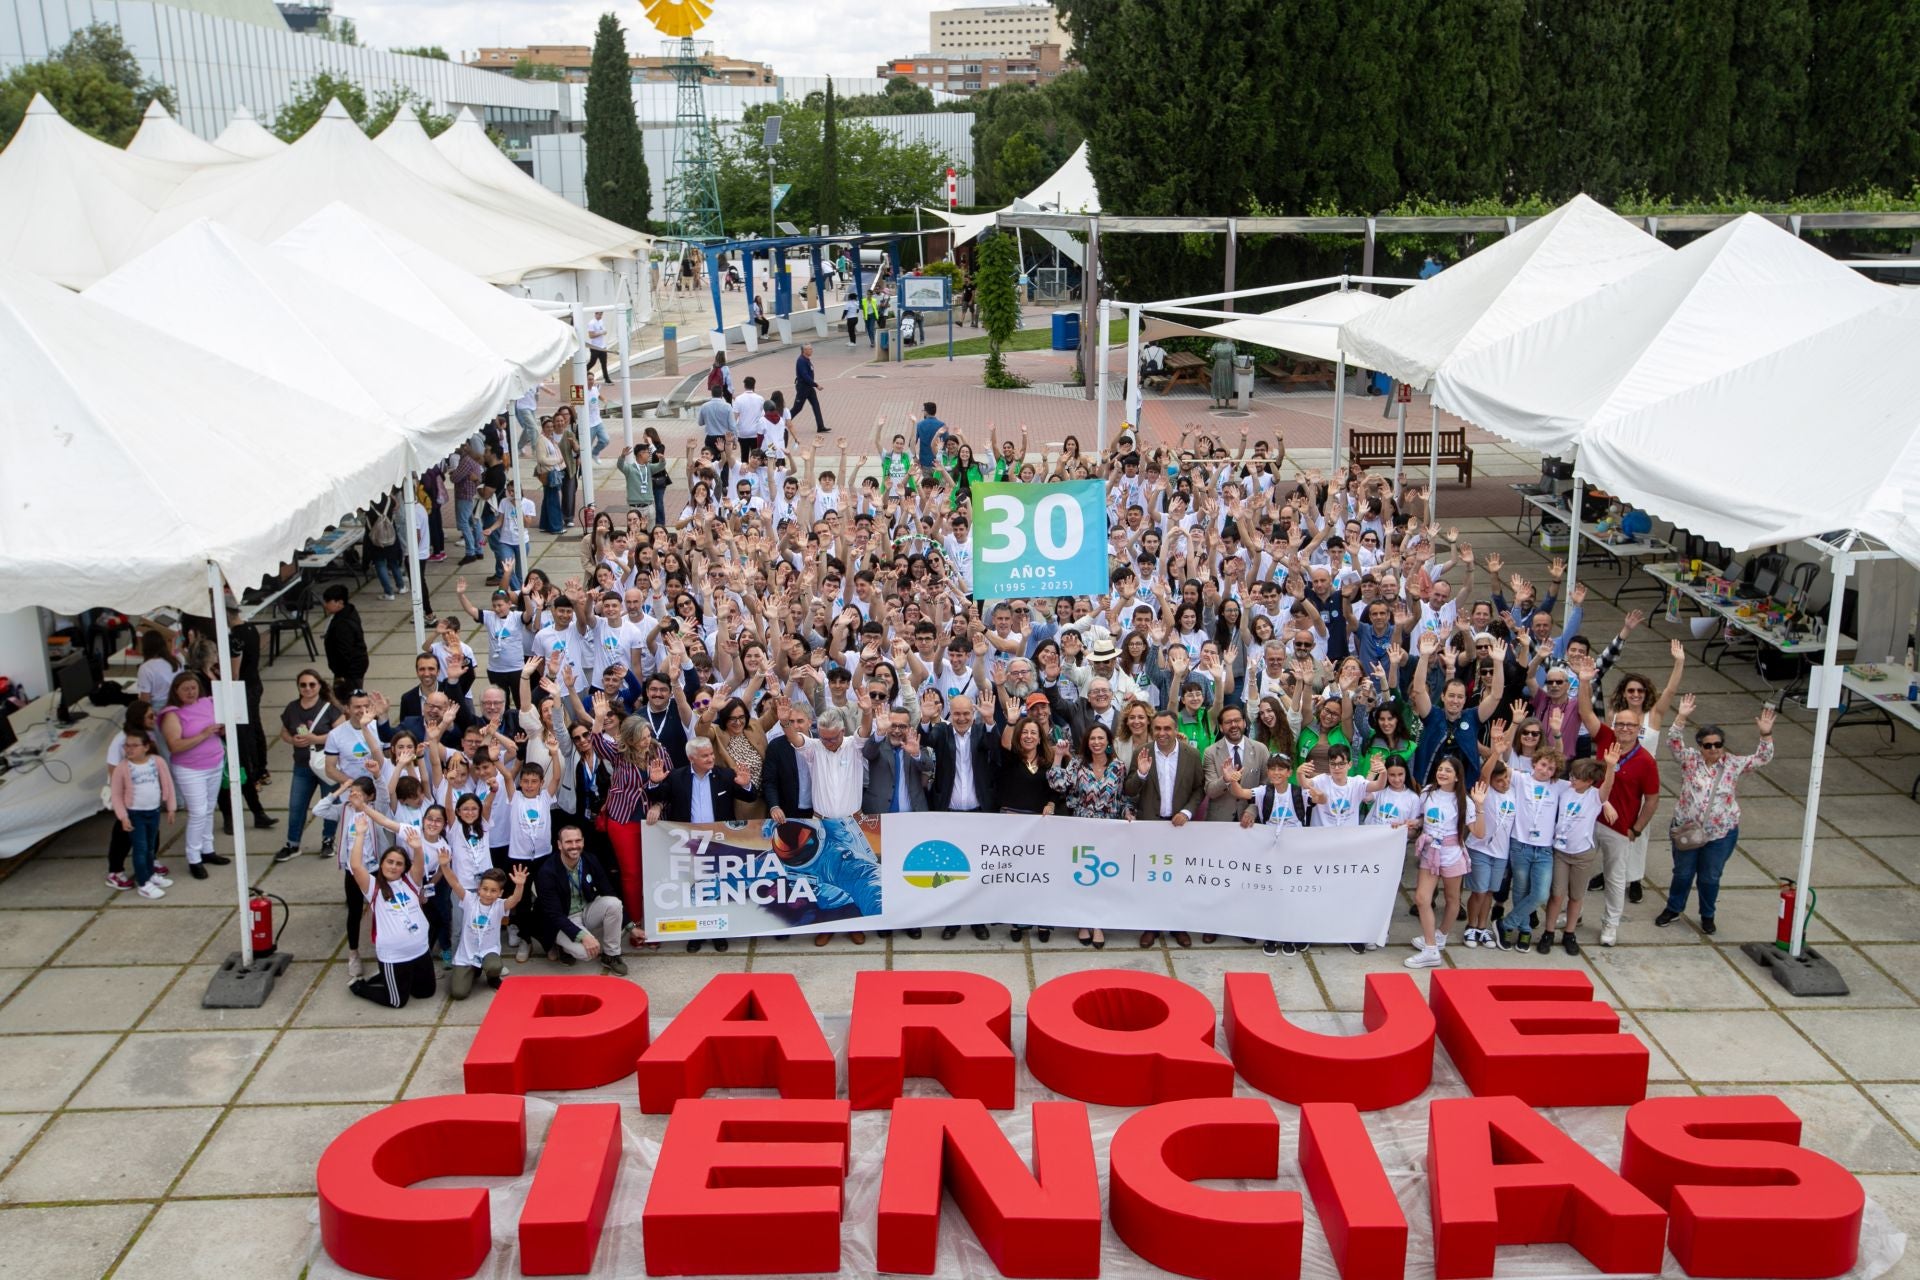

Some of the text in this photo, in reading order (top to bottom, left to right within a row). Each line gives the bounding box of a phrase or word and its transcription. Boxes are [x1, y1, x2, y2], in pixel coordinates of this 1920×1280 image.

[982, 493, 1084, 563] 30
[1010, 564, 1056, 579] AÑOS
[994, 582, 1026, 593] (1995
[1041, 581, 1073, 591] 2025)
[981, 844, 1045, 857] PARQUE
[670, 852, 787, 881] FERIA
[981, 860, 1013, 870] de las
[1149, 853, 1381, 875] 15 MILLONES DE VISITAS
[981, 872, 1050, 885] CIENCIAS
[1147, 870, 1173, 883] 30
[1185, 873, 1231, 888] AÑOS
[1241, 882, 1273, 892] (1995
[1290, 885, 1322, 893] 2025)
[653, 877, 818, 910] CIENCIA
[699, 919, 718, 927] FECYT
[463, 968, 1650, 1115] PARQUE
[316, 1092, 1866, 1280] CIENCIAS
